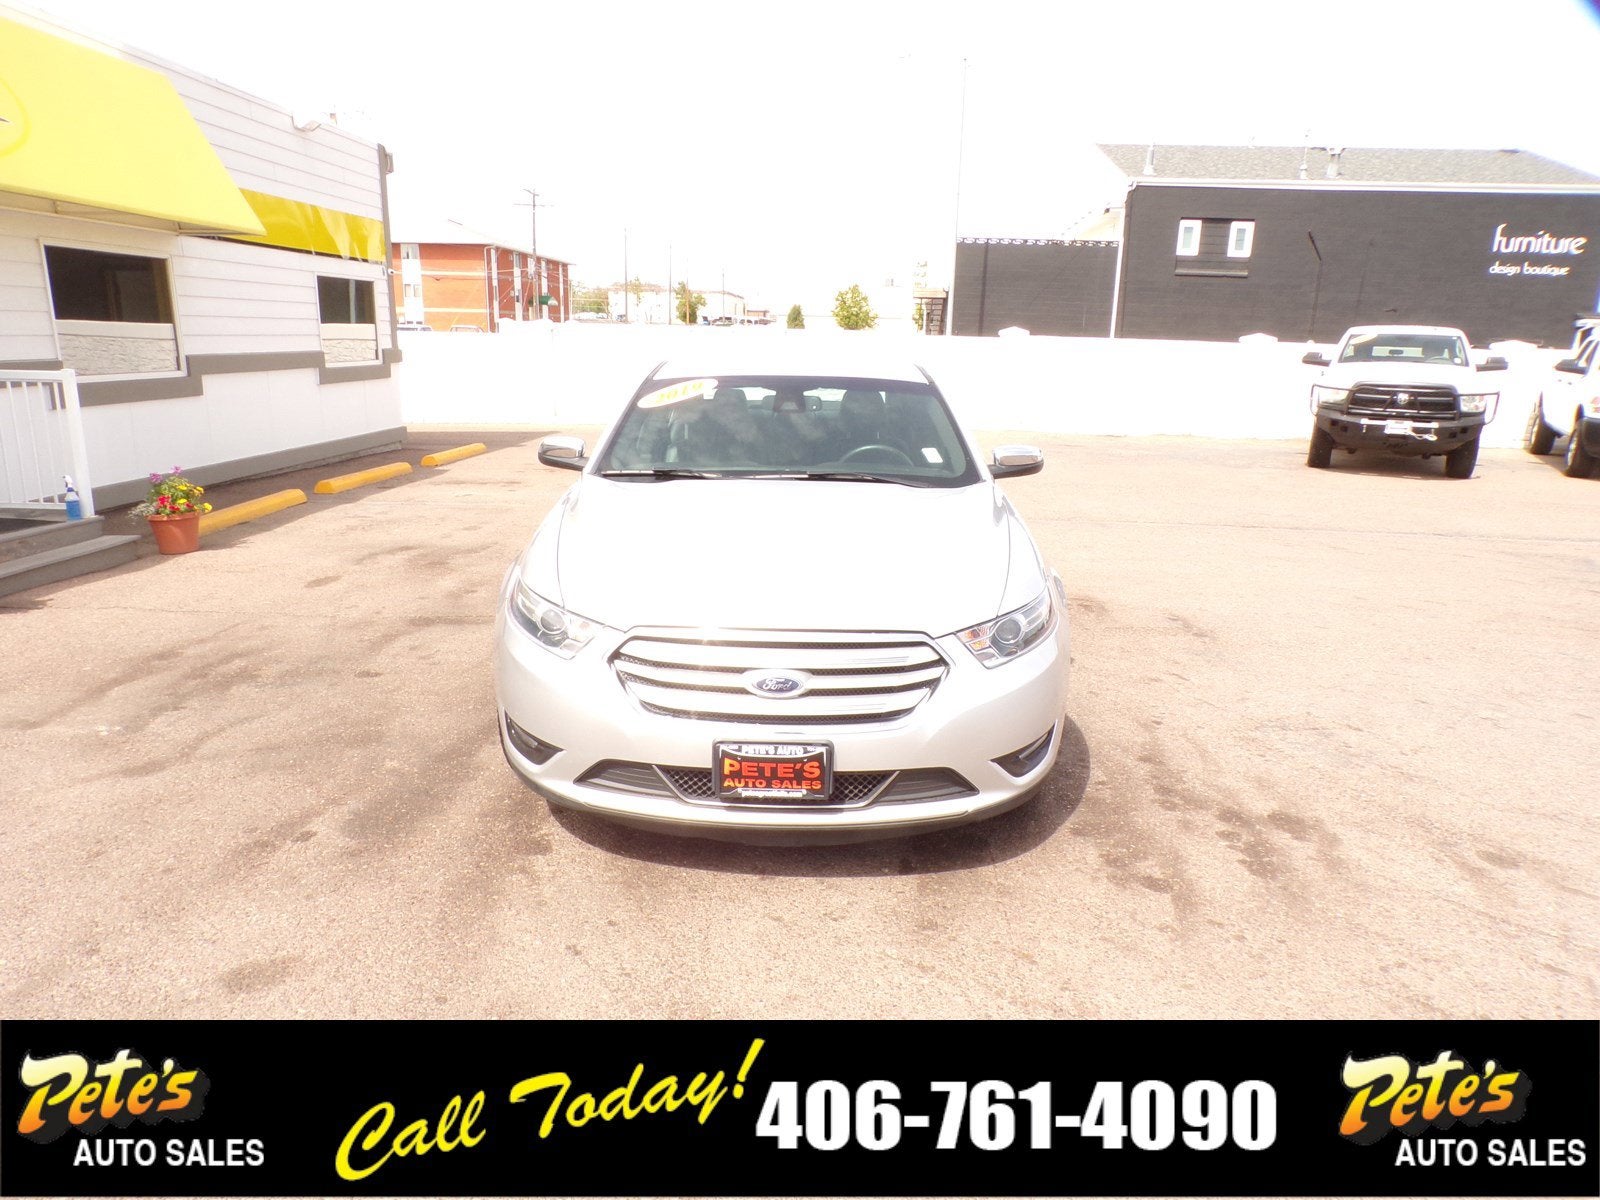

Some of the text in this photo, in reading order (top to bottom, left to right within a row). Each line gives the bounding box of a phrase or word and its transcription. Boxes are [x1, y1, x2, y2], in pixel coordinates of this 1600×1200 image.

[1491, 223, 1588, 256] furniture
[1488, 260, 1571, 277] design boutique
[762, 677, 793, 690] Ford
[723, 757, 821, 779] PETE'S
[723, 778, 822, 790] AUTO SALES
